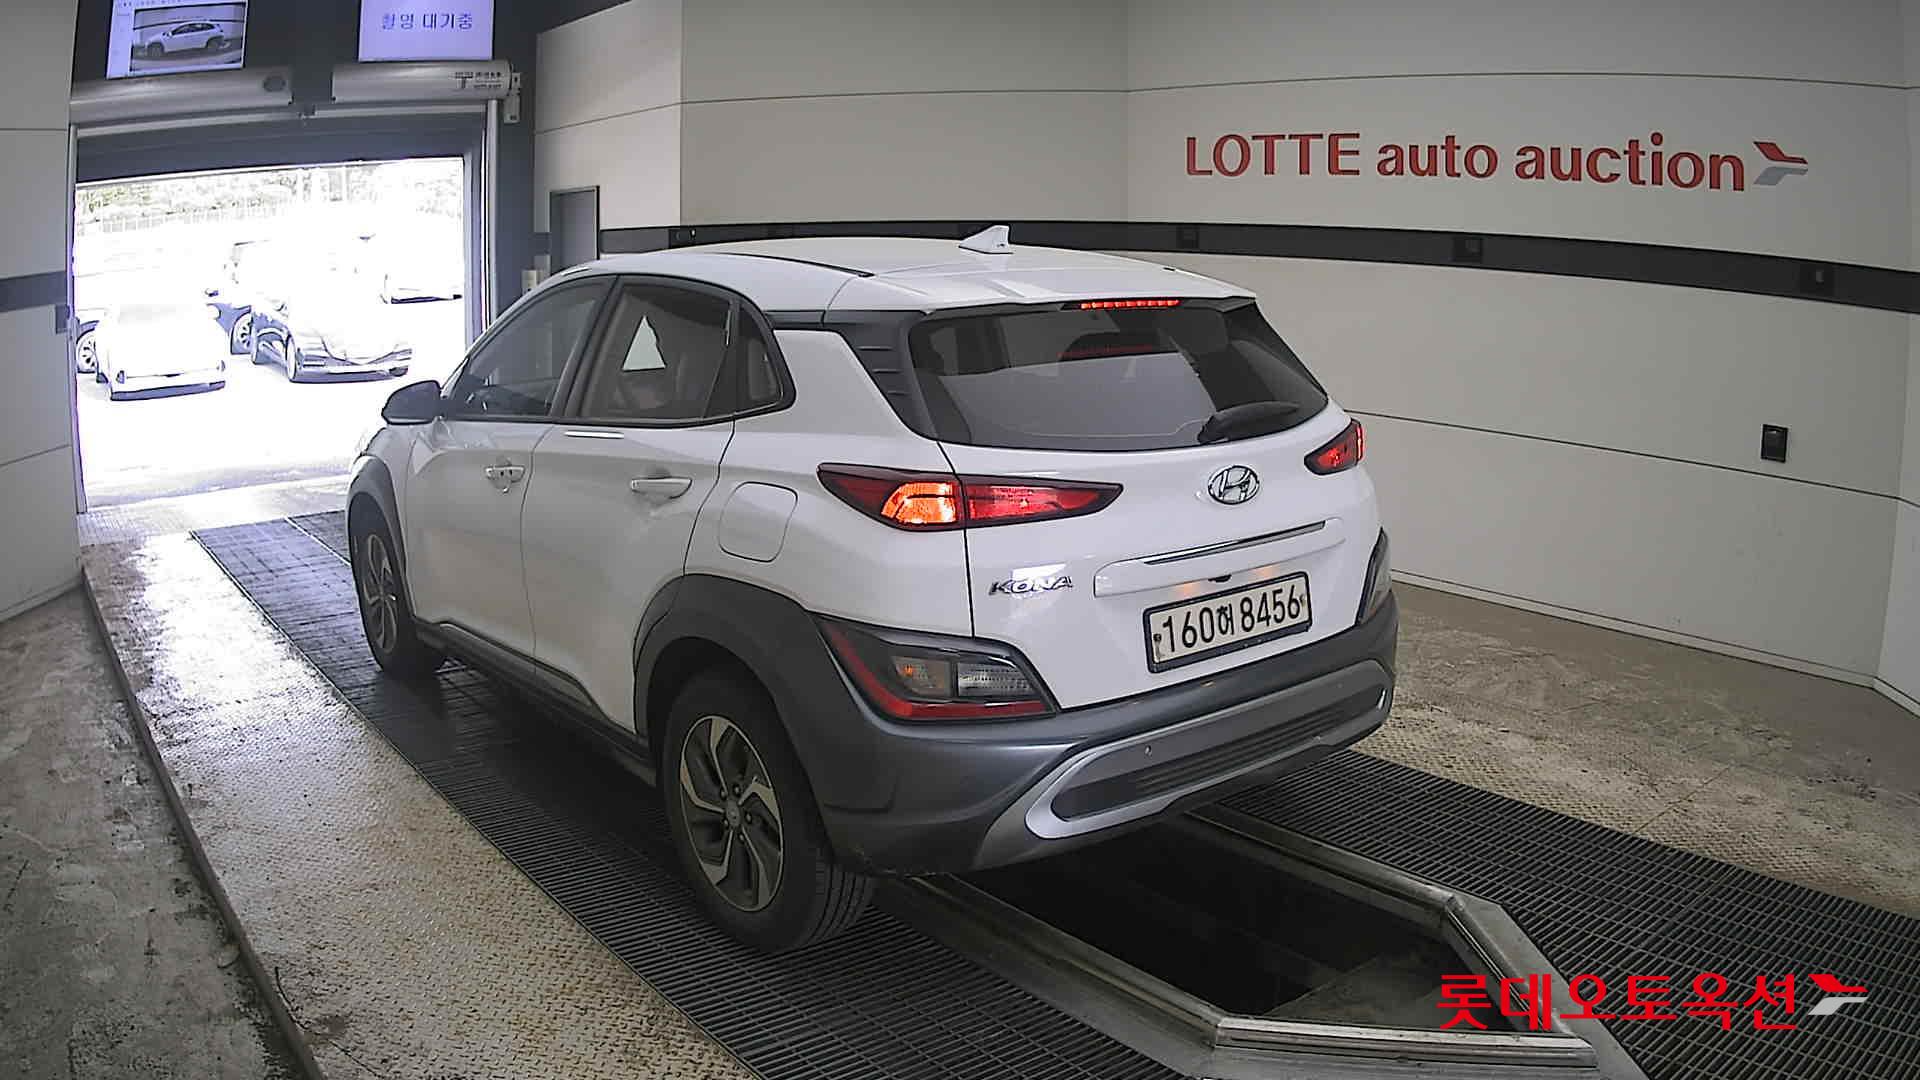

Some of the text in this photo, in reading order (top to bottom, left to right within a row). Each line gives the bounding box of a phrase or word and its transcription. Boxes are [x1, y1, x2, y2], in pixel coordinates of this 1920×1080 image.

[422, 12, 473, 30] 대기중
[1187, 132, 1745, 191] LOTTE auto auction
[988, 576, 1074, 596] KONA
[1239, 584, 1301, 633] 8456
